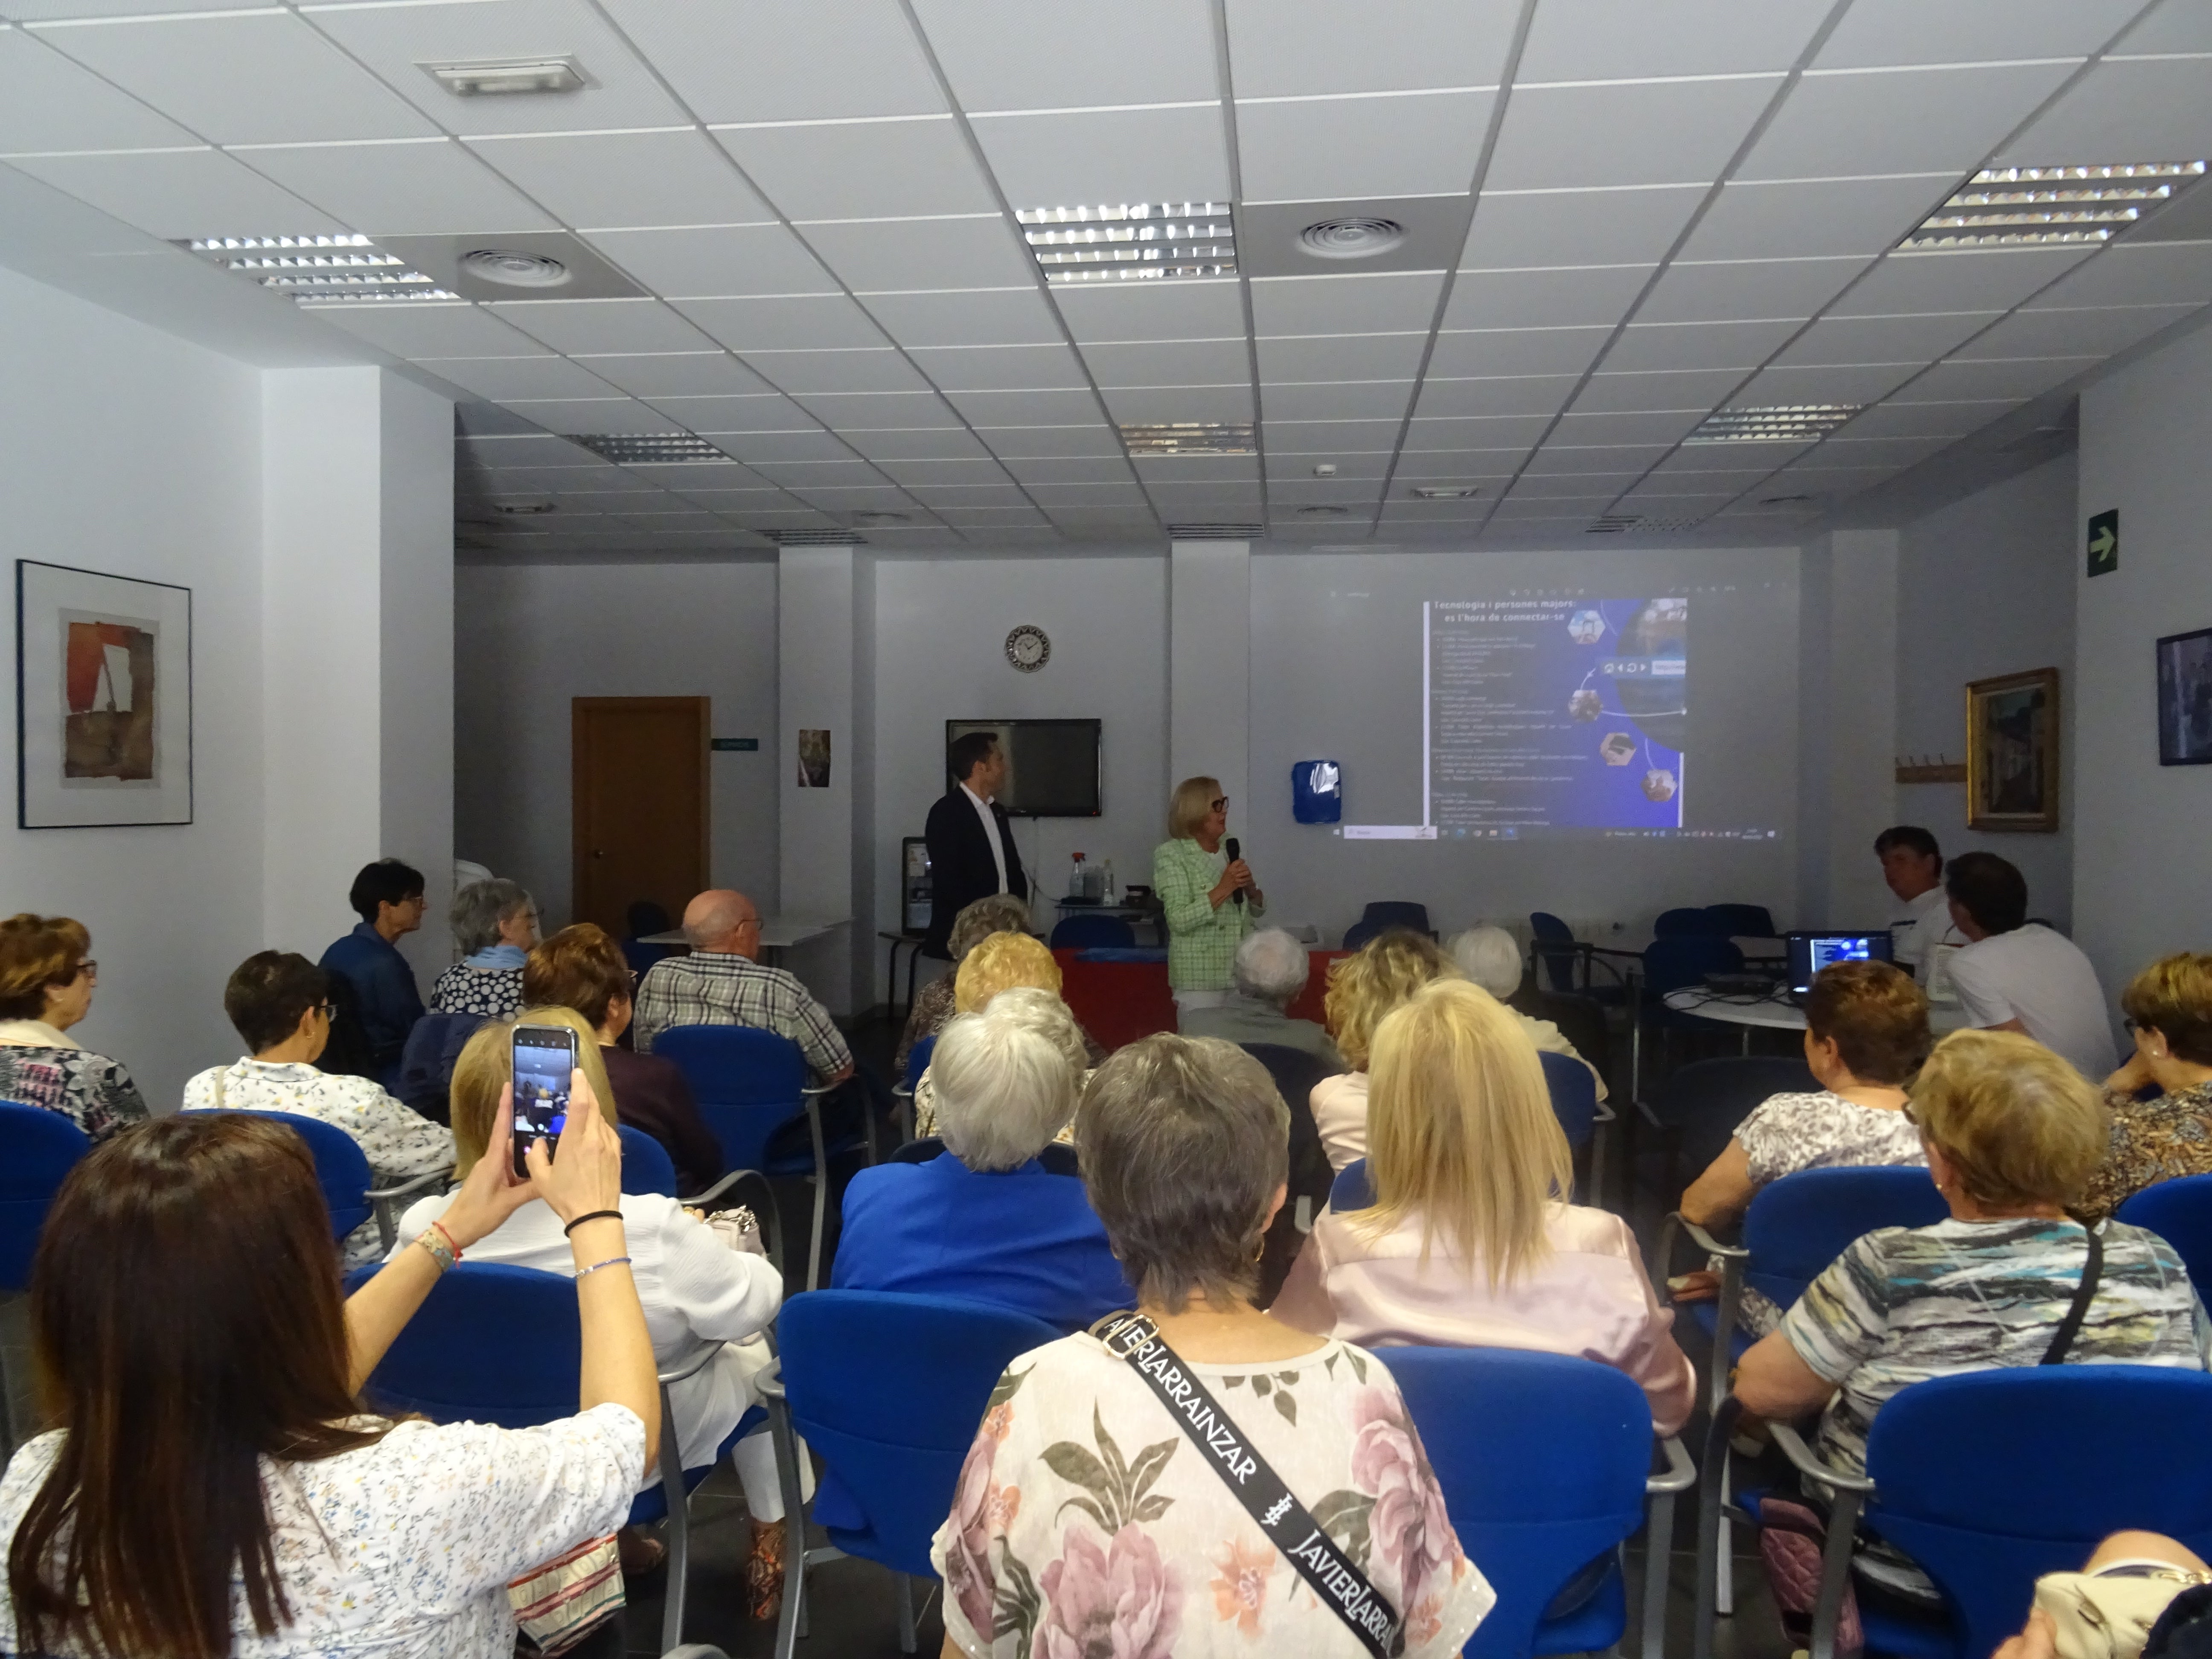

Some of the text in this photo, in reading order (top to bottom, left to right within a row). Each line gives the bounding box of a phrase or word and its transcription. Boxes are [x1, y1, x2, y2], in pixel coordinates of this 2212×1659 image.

[1434, 600, 1486, 611] Tecnologia
[1494, 600, 1538, 610] persones
[1488, 612, 1500, 622] de
[1503, 613, 1565, 622] connectar-se
